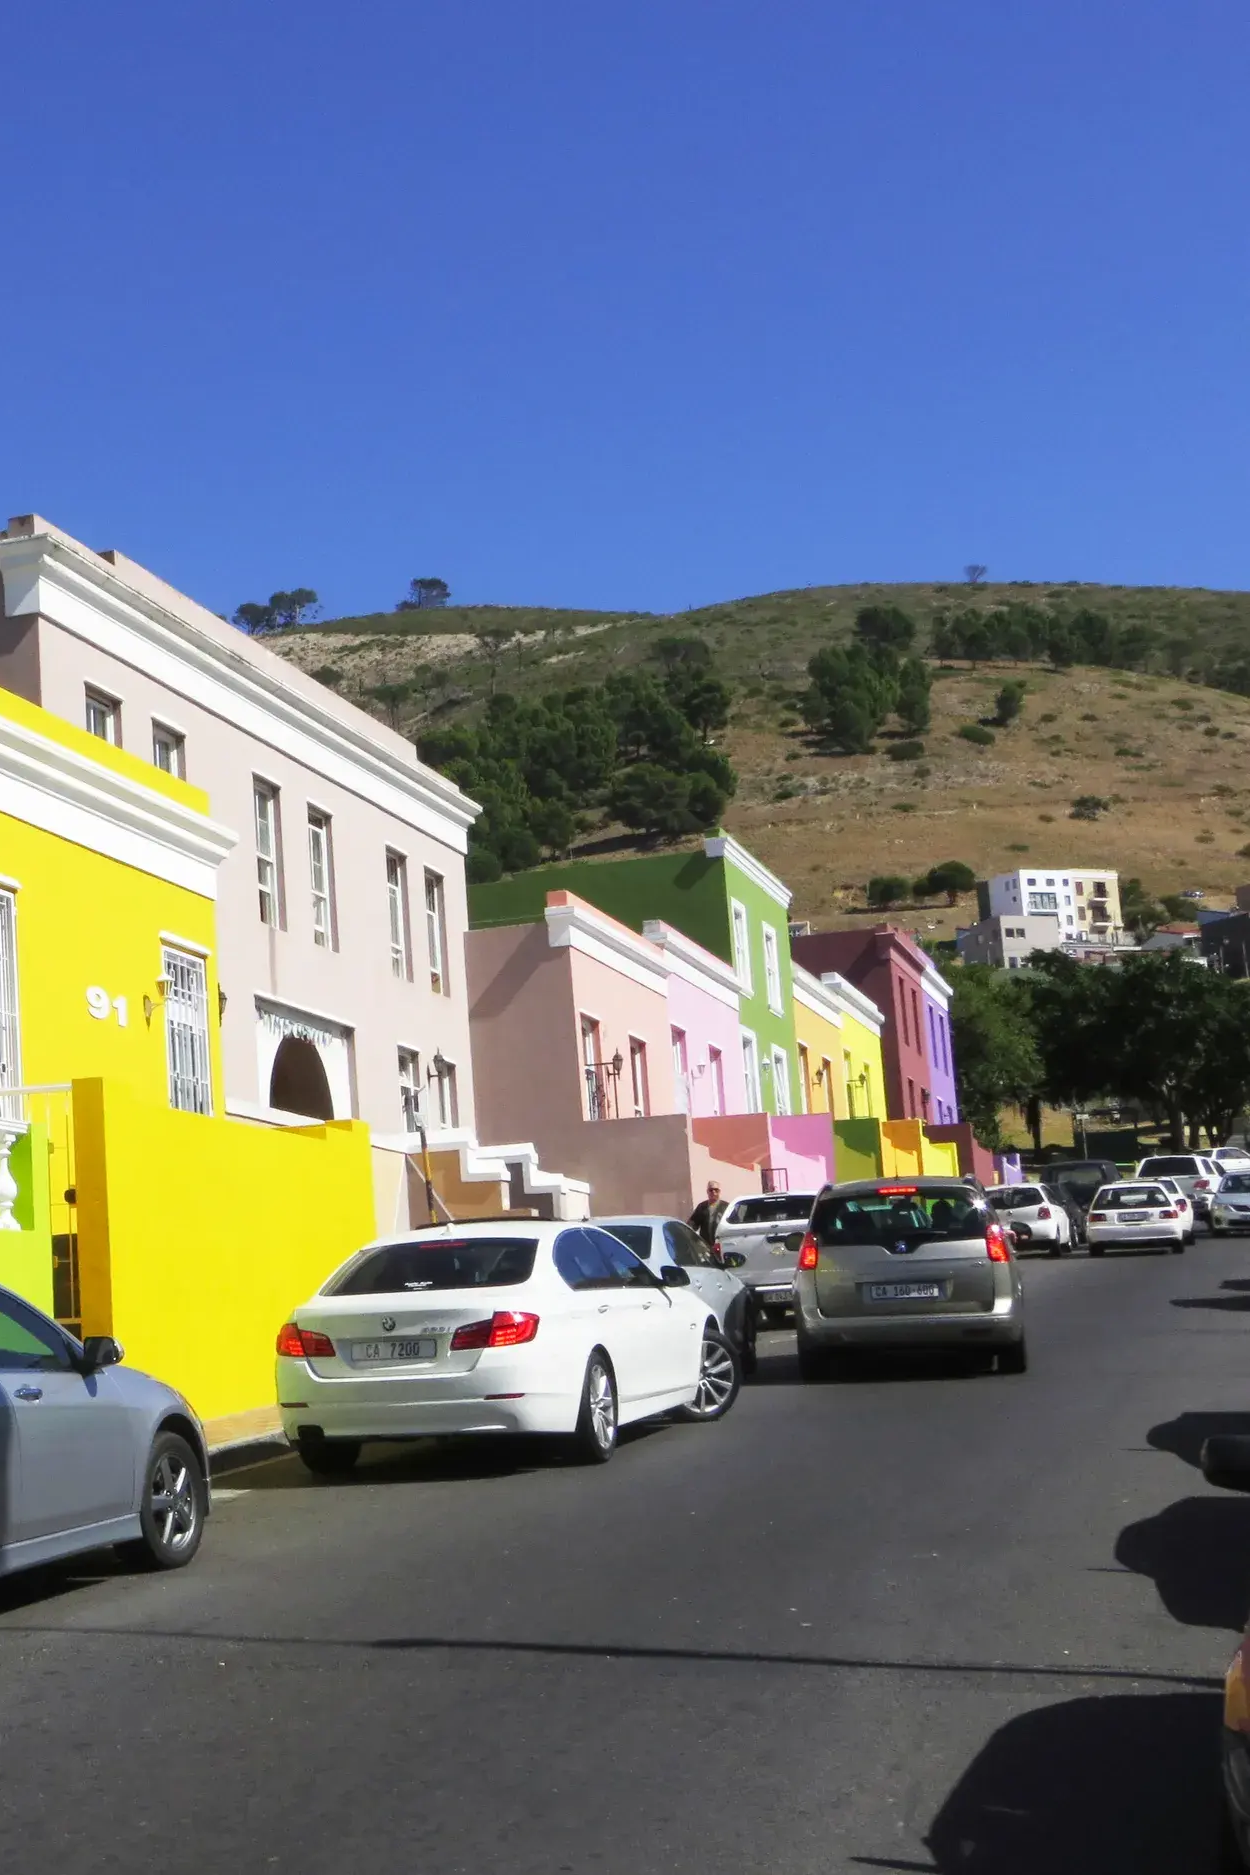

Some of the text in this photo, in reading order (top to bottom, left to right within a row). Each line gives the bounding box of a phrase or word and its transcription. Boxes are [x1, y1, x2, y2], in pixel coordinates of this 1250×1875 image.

[86, 986, 127, 1027] 91
[875, 1286, 887, 1297] CA
[365, 1342, 420, 1358] CA 7200
